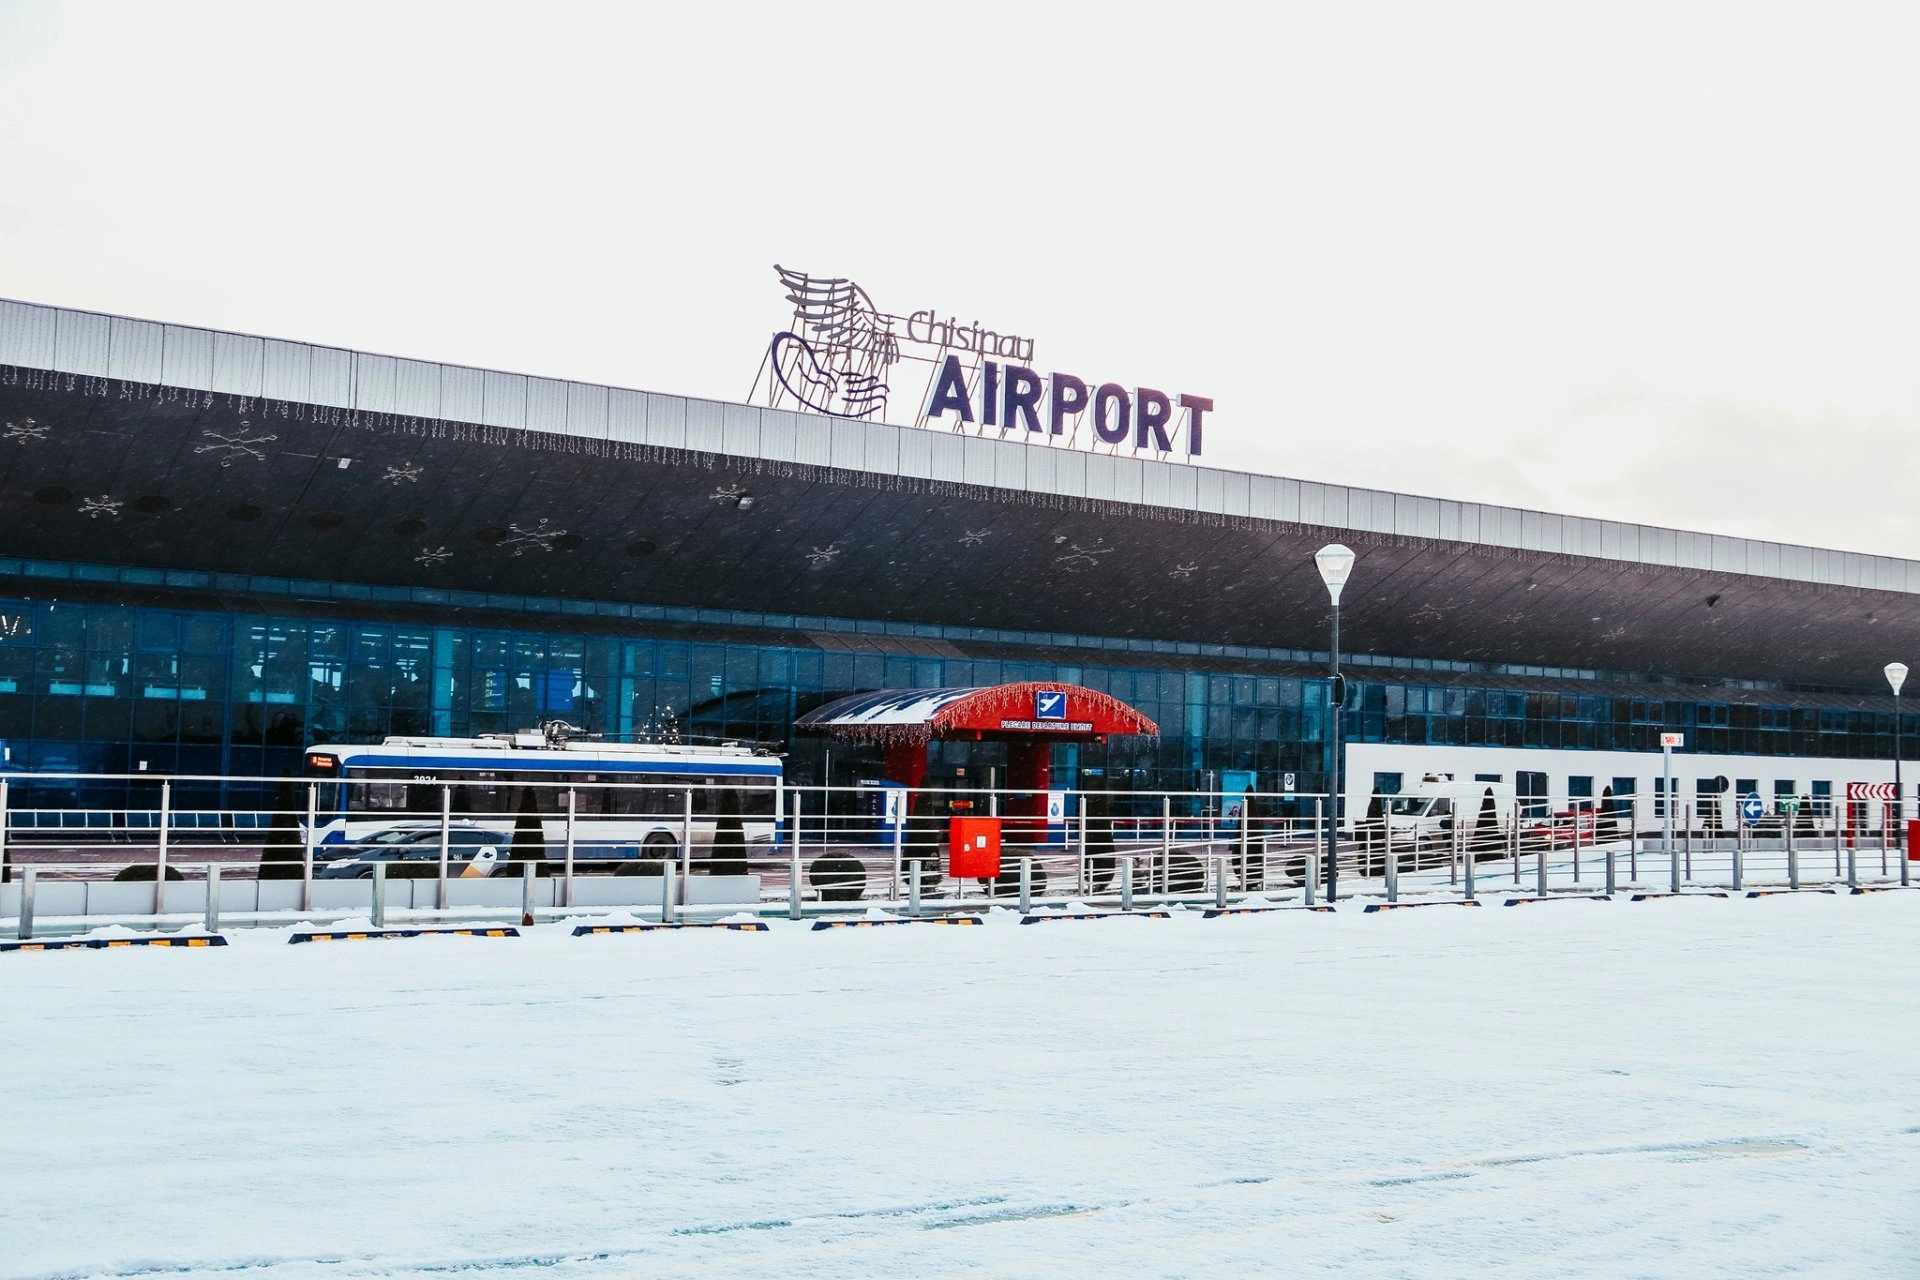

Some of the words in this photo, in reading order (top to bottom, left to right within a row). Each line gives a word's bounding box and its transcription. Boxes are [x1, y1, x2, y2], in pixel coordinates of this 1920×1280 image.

[907, 309, 1034, 361] Chisinau
[923, 354, 1214, 456] AIRPORT
[1001, 720, 1031, 729] PLECARE
[1032, 721, 1069, 731] DEPARTURE
